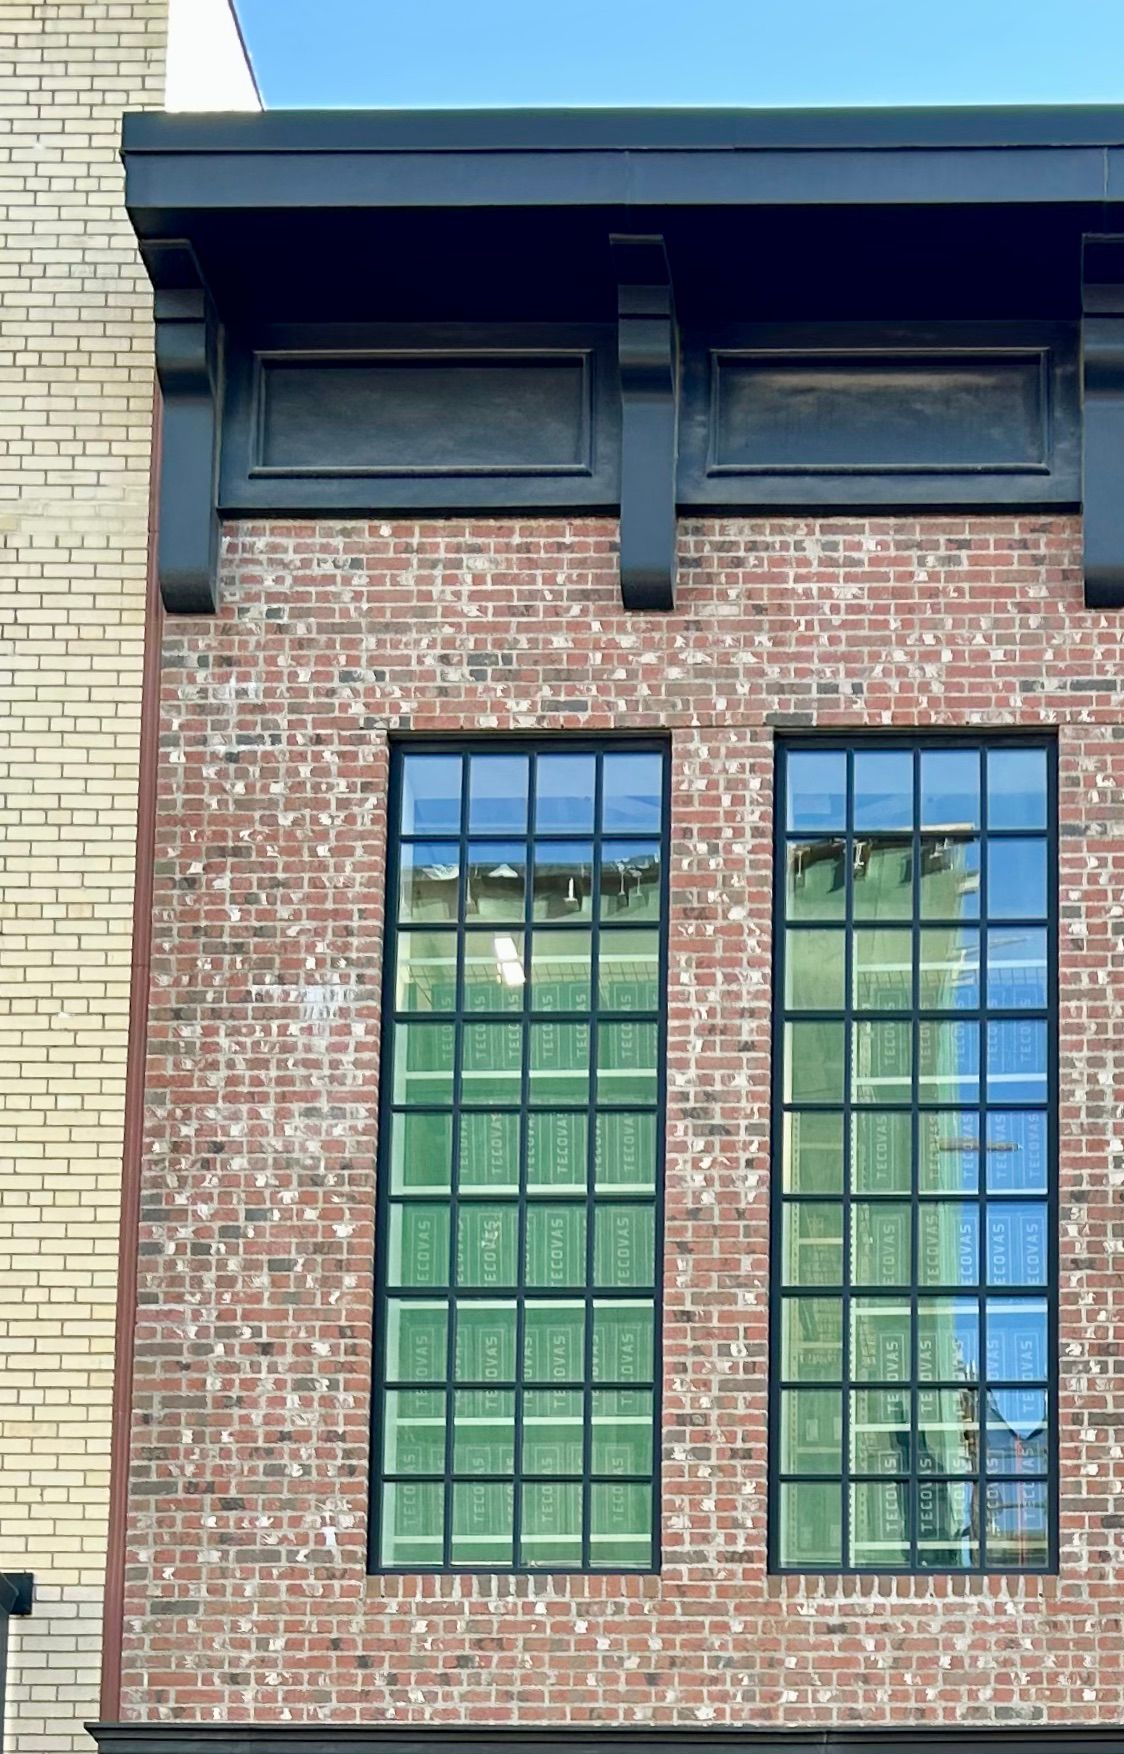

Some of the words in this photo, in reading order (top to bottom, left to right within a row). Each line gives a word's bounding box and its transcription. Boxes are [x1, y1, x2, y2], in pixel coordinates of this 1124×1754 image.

[485, 1336, 497, 1408] TEOVAS
[554, 1336, 566, 1408] TEOVAS
[887, 1341, 898, 1413] TEOVAS
[921, 1340, 932, 1413] TEOVAS
[1021, 1341, 1033, 1413] TEOVAS
